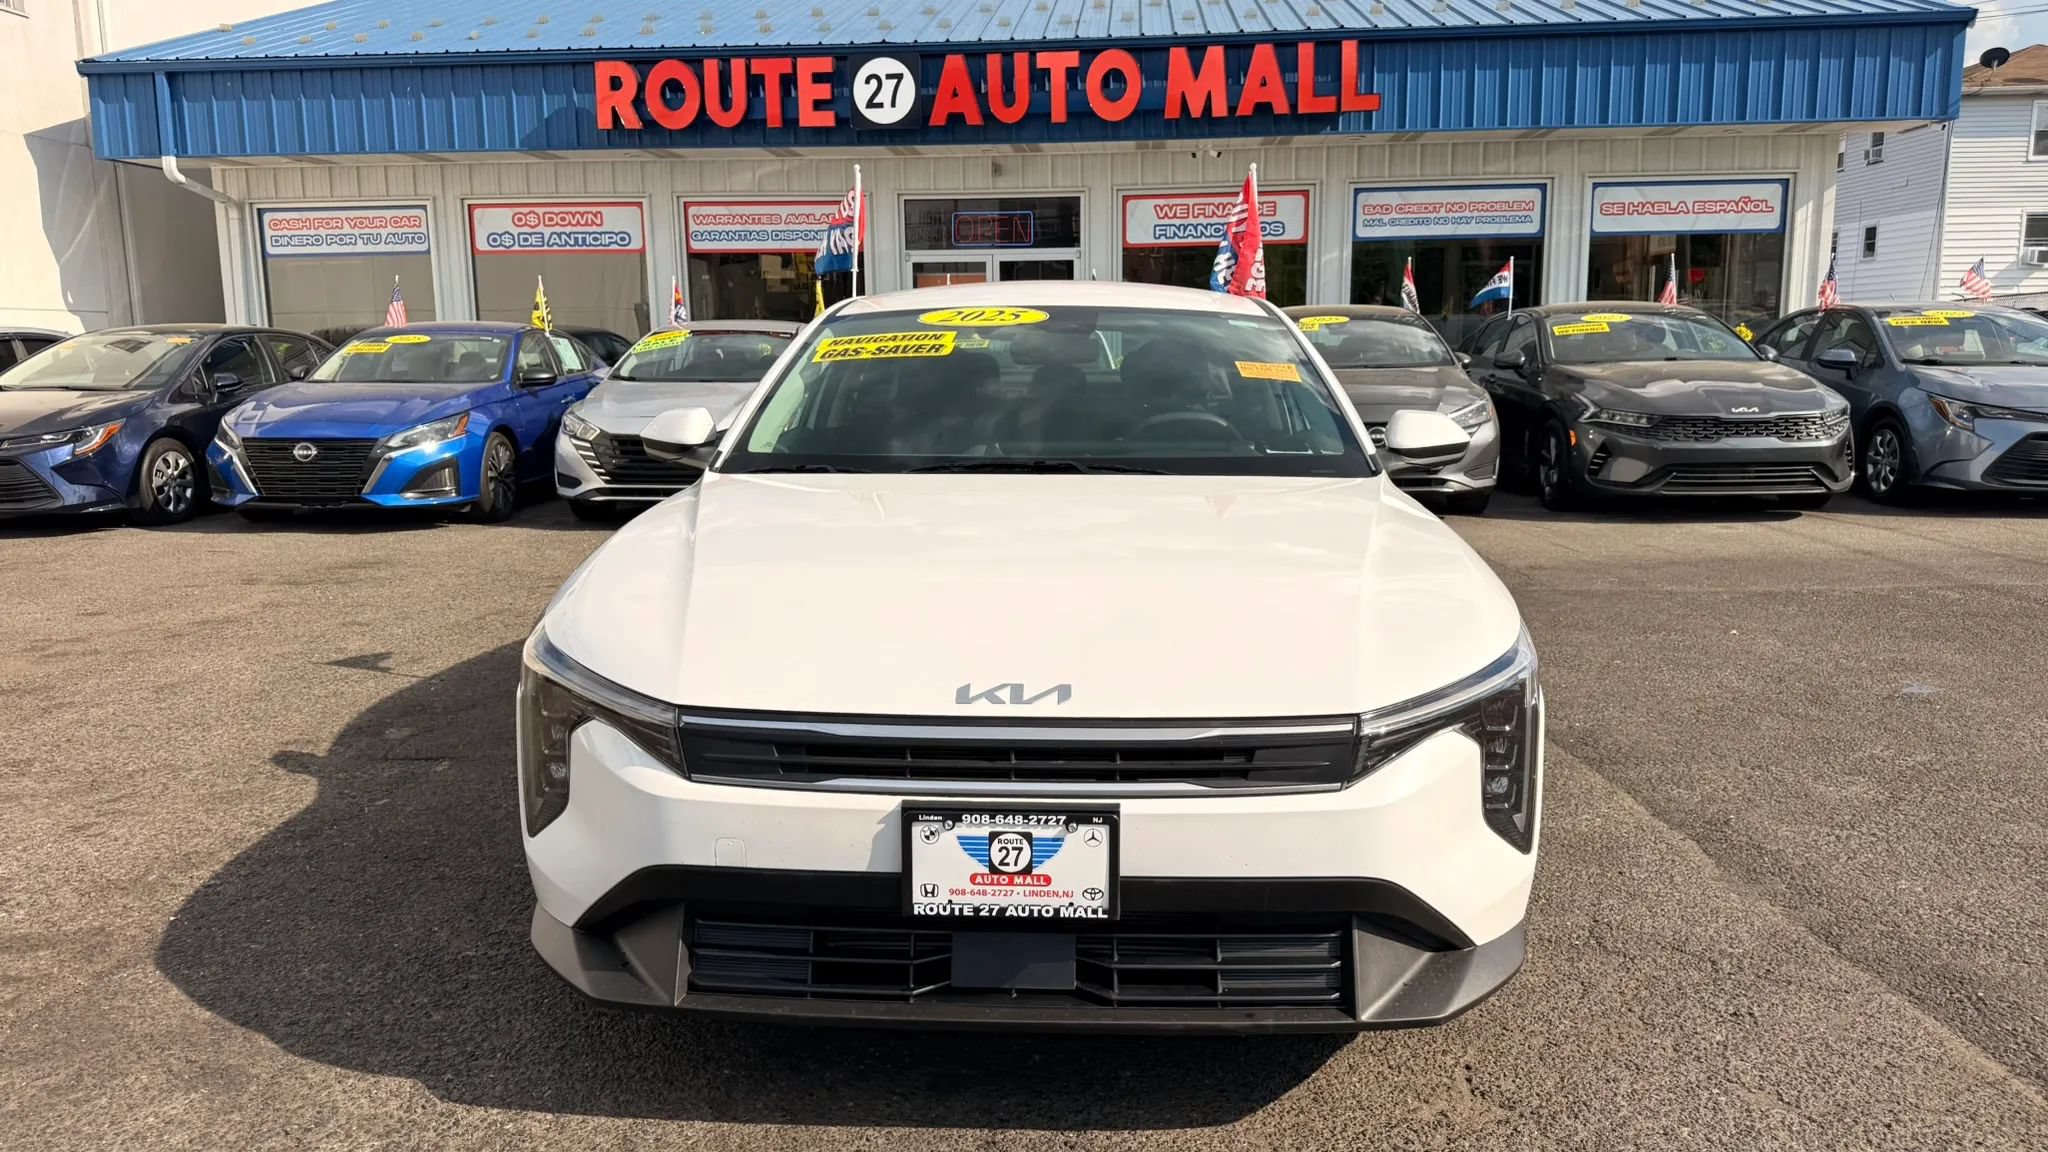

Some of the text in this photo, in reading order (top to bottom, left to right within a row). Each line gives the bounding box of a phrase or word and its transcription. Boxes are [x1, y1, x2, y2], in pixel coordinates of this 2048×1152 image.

[594, 39, 1381, 130] ROUTE 27 AUTO MALL
[1154, 203, 1189, 219] WE
[1363, 200, 1535, 215] BAD CREDIT NO PROBLEM
[1600, 196, 1775, 216] SE HABLA ESPAÑOL
[269, 215, 422, 231] CASH FOR YOUR CAR
[544, 211, 603, 226] DOWN
[692, 213, 781, 226] WARRANTIES
[1363, 214, 1533, 227] MAL CREDITO NO HAY PROBLEMA
[691, 230, 769, 242] GARANTIAS
[955, 214, 1030, 244] OPEN
[271, 232, 427, 247] DINERO POR TU AUTO
[517, 232, 544, 247] DE
[546, 231, 631, 247] ANTICIPO
[941, 310, 1025, 323] 2025
[828, 333, 944, 347] NAVIGATION
[820, 344, 949, 360] GAS-SAVER
[962, 814, 1067, 826] 908-648-2727
[997, 838, 1024, 846] ROUTE
[998, 846, 1024, 867] 27
[974, 875, 1047, 886] AUTO MALL
[949, 888, 1074, 899] 908-648-2727 LINDEN,NJ
[913, 903, 1108, 919] ROUTE 27 AUTO MALL
